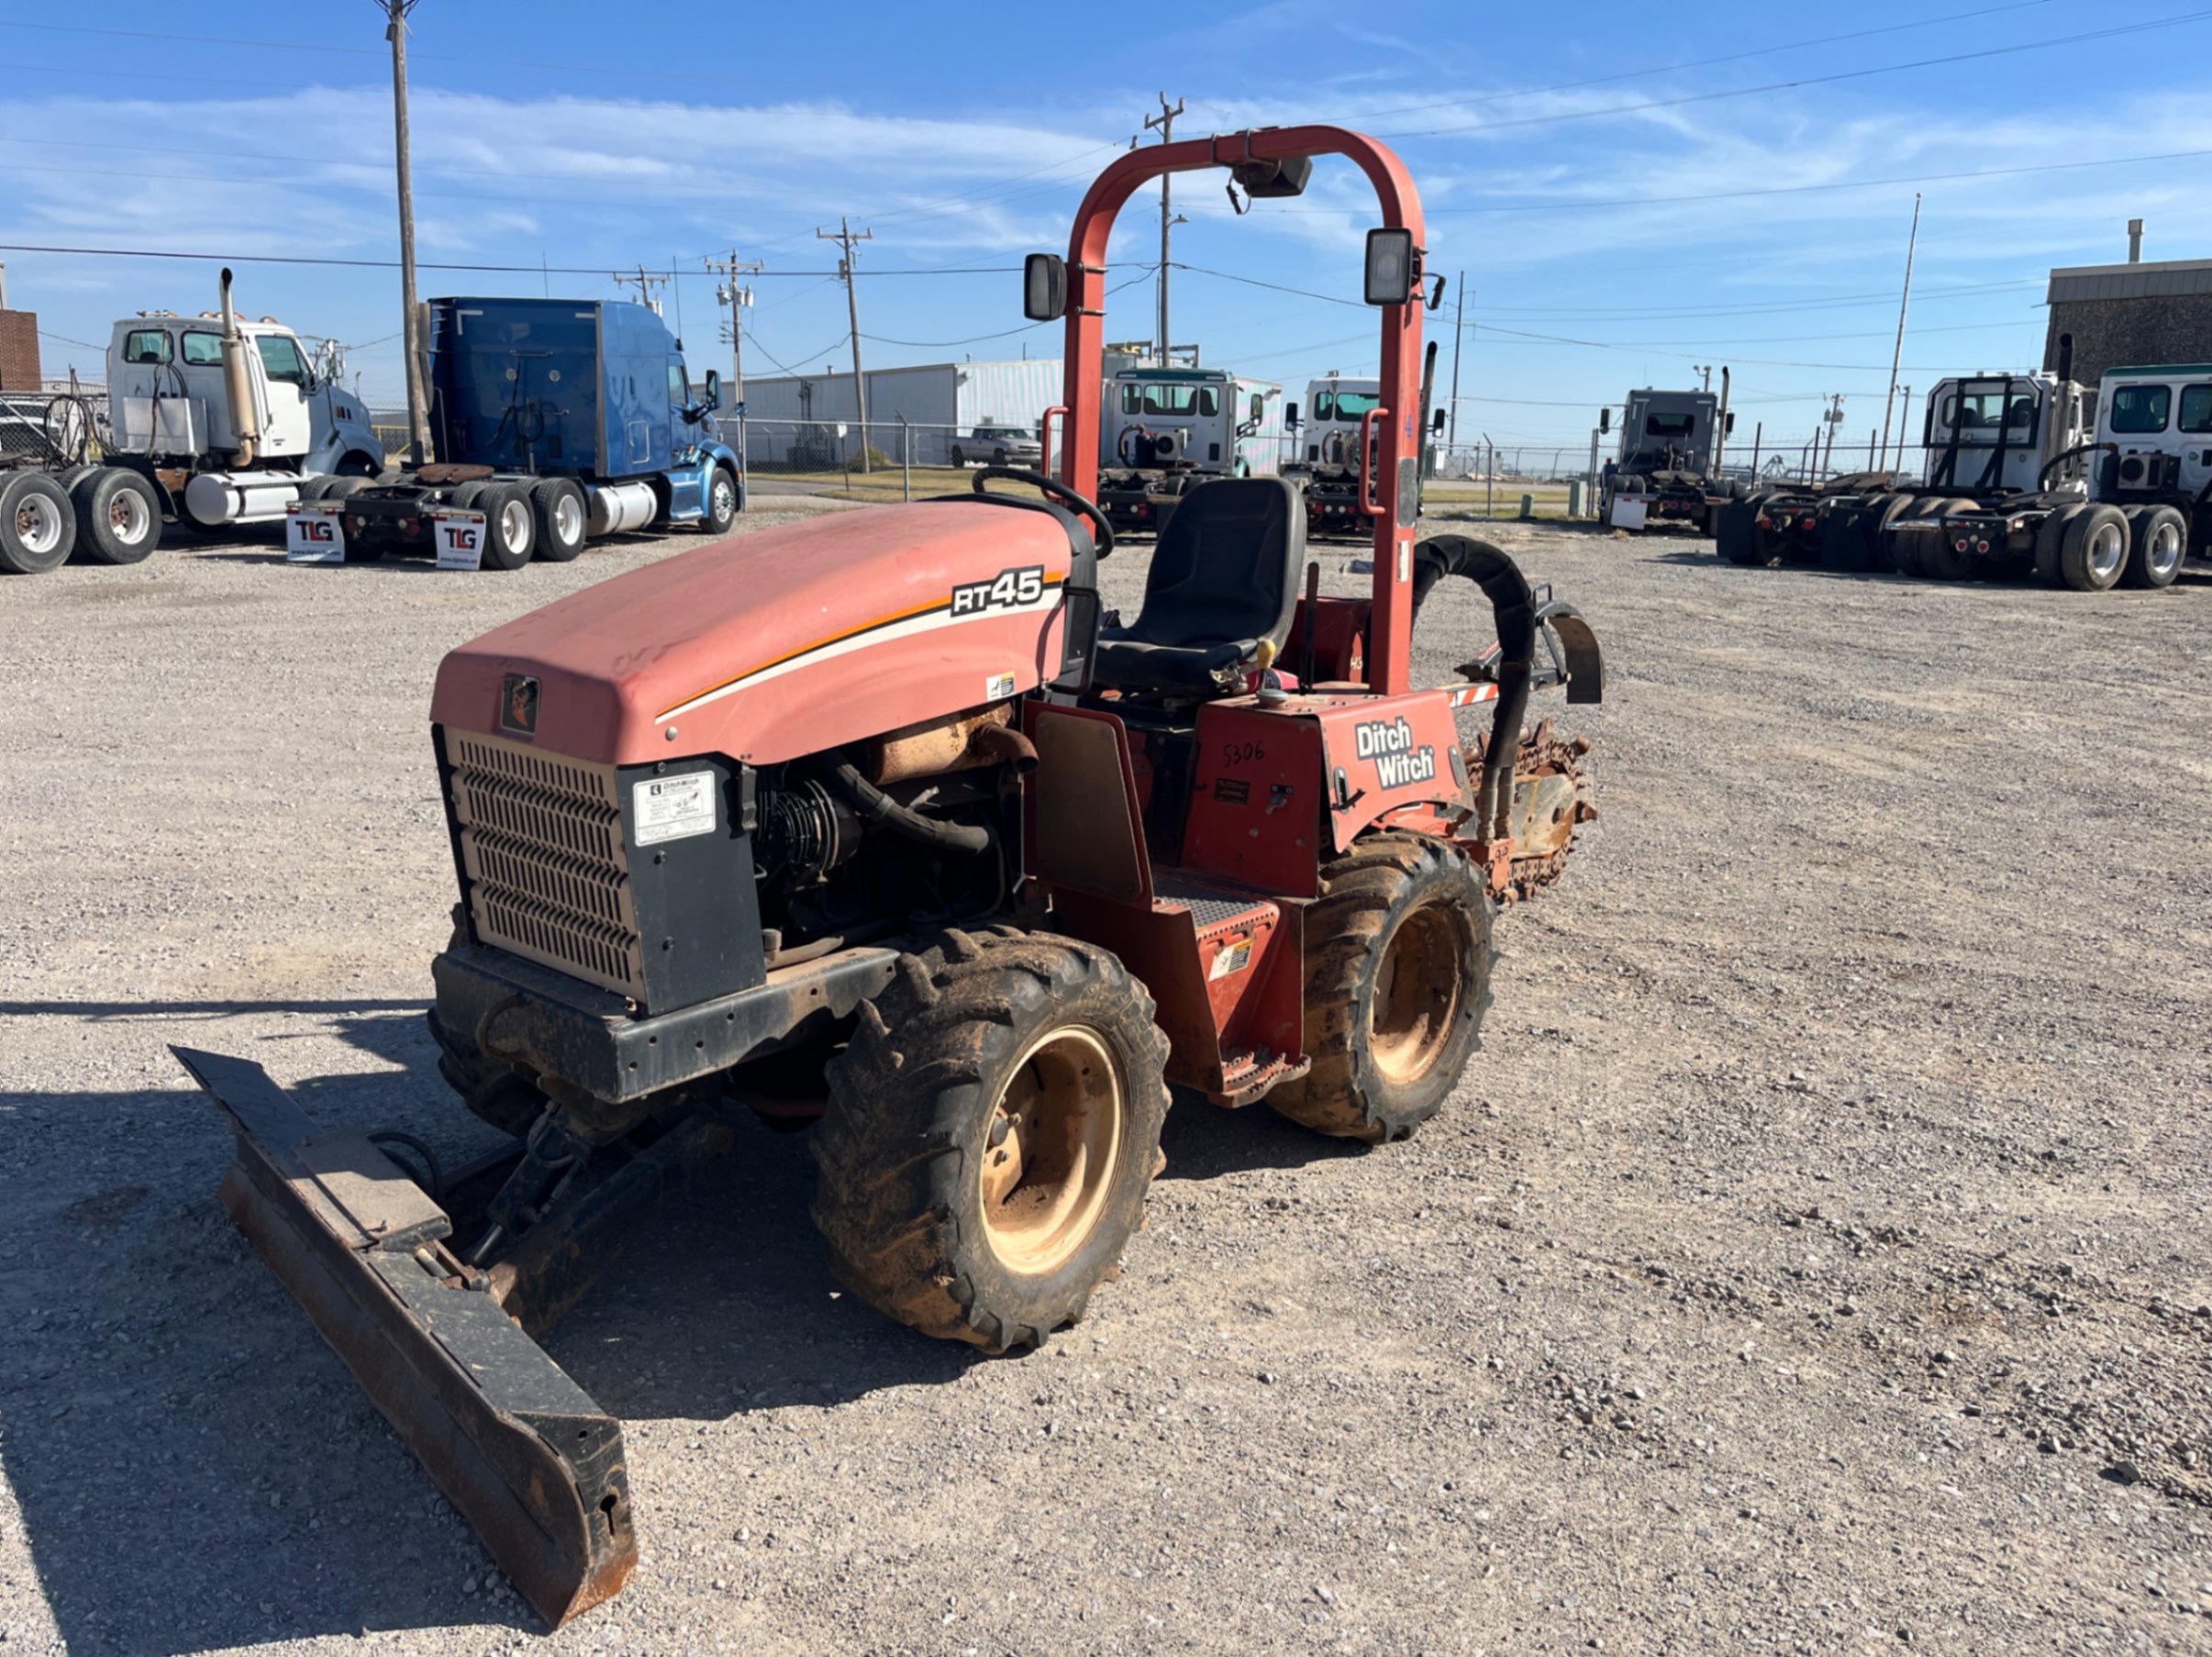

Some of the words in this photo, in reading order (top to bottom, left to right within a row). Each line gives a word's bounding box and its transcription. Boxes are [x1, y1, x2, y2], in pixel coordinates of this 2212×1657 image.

[295, 520, 334, 541] TLG
[444, 527, 477, 550] TLG
[954, 569, 1042, 613] RT45
[1223, 740, 1265, 769] 5306
[1356, 717, 1412, 758] Ditch
[1375, 748, 1434, 788] Witch
